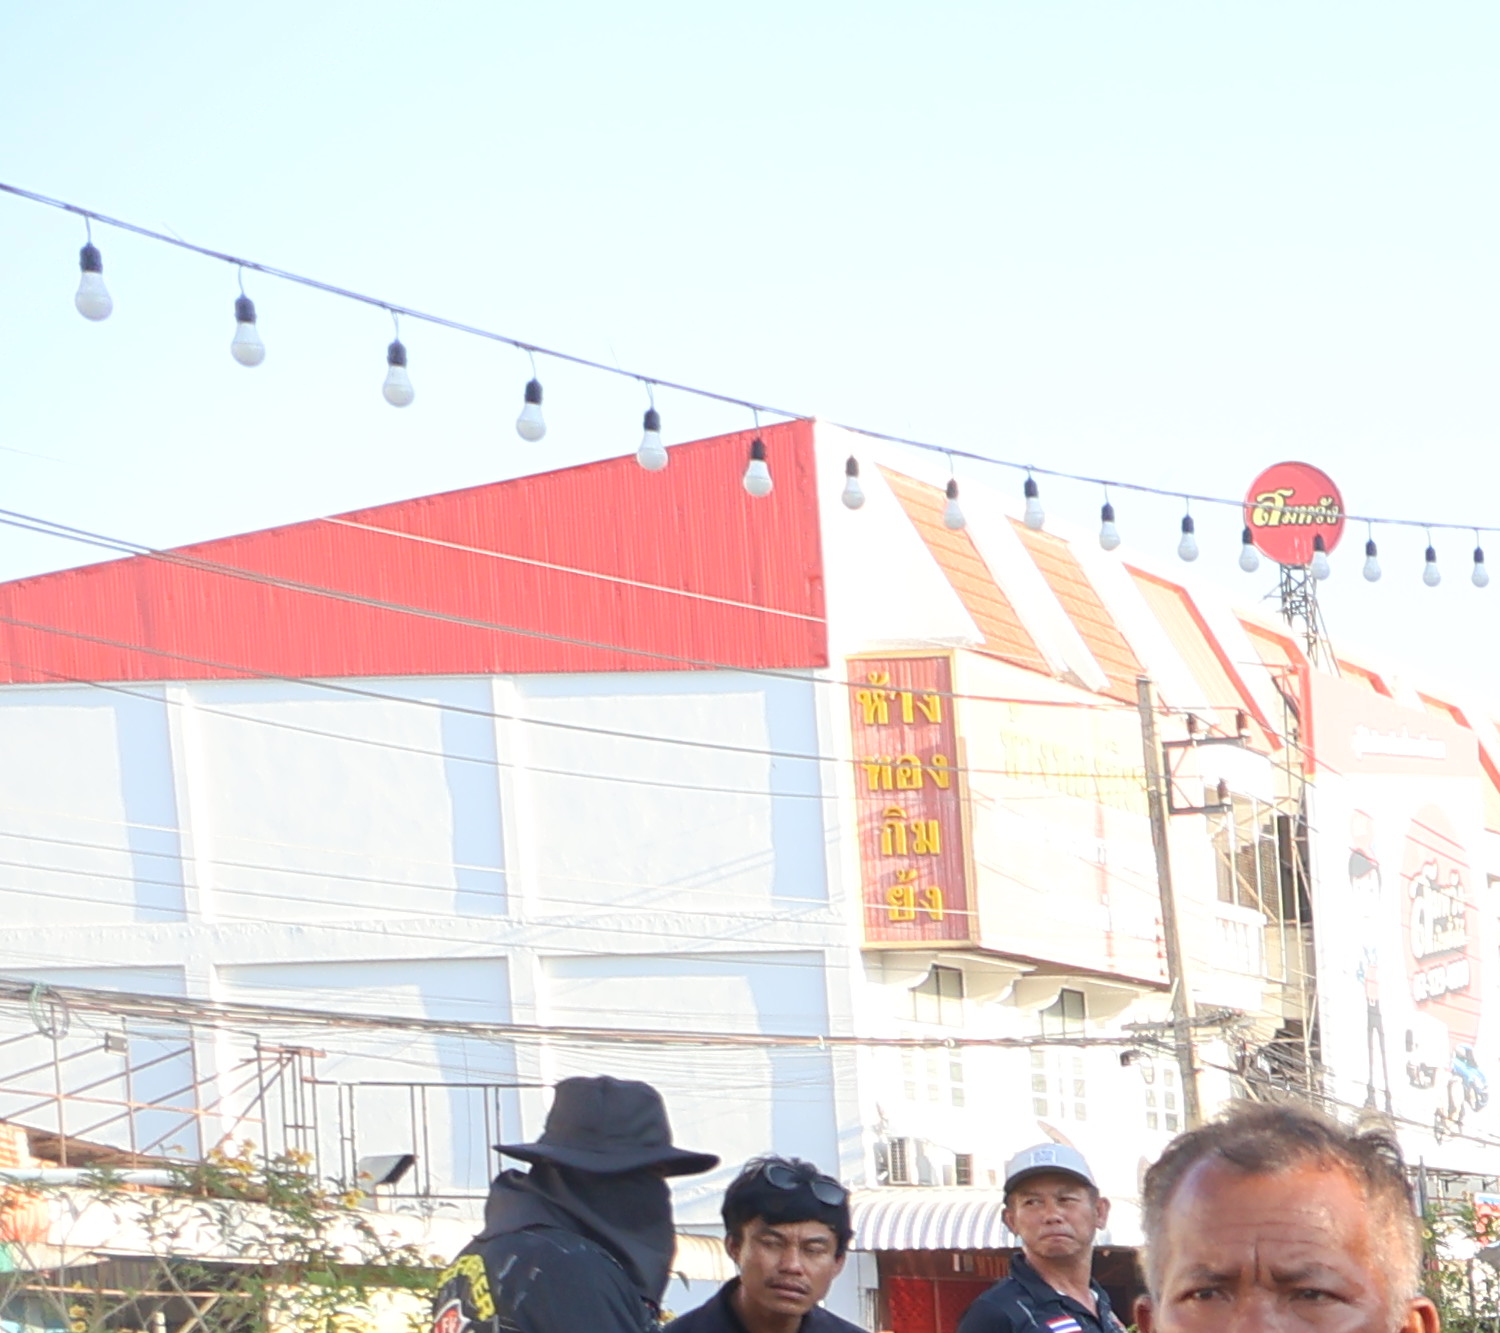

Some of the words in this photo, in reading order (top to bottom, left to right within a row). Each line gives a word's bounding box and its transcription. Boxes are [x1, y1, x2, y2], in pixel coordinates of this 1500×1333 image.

[856, 671, 941, 724] ห้าง
[861, 753, 950, 791] ทอง
[880, 805, 940, 856] กิม
